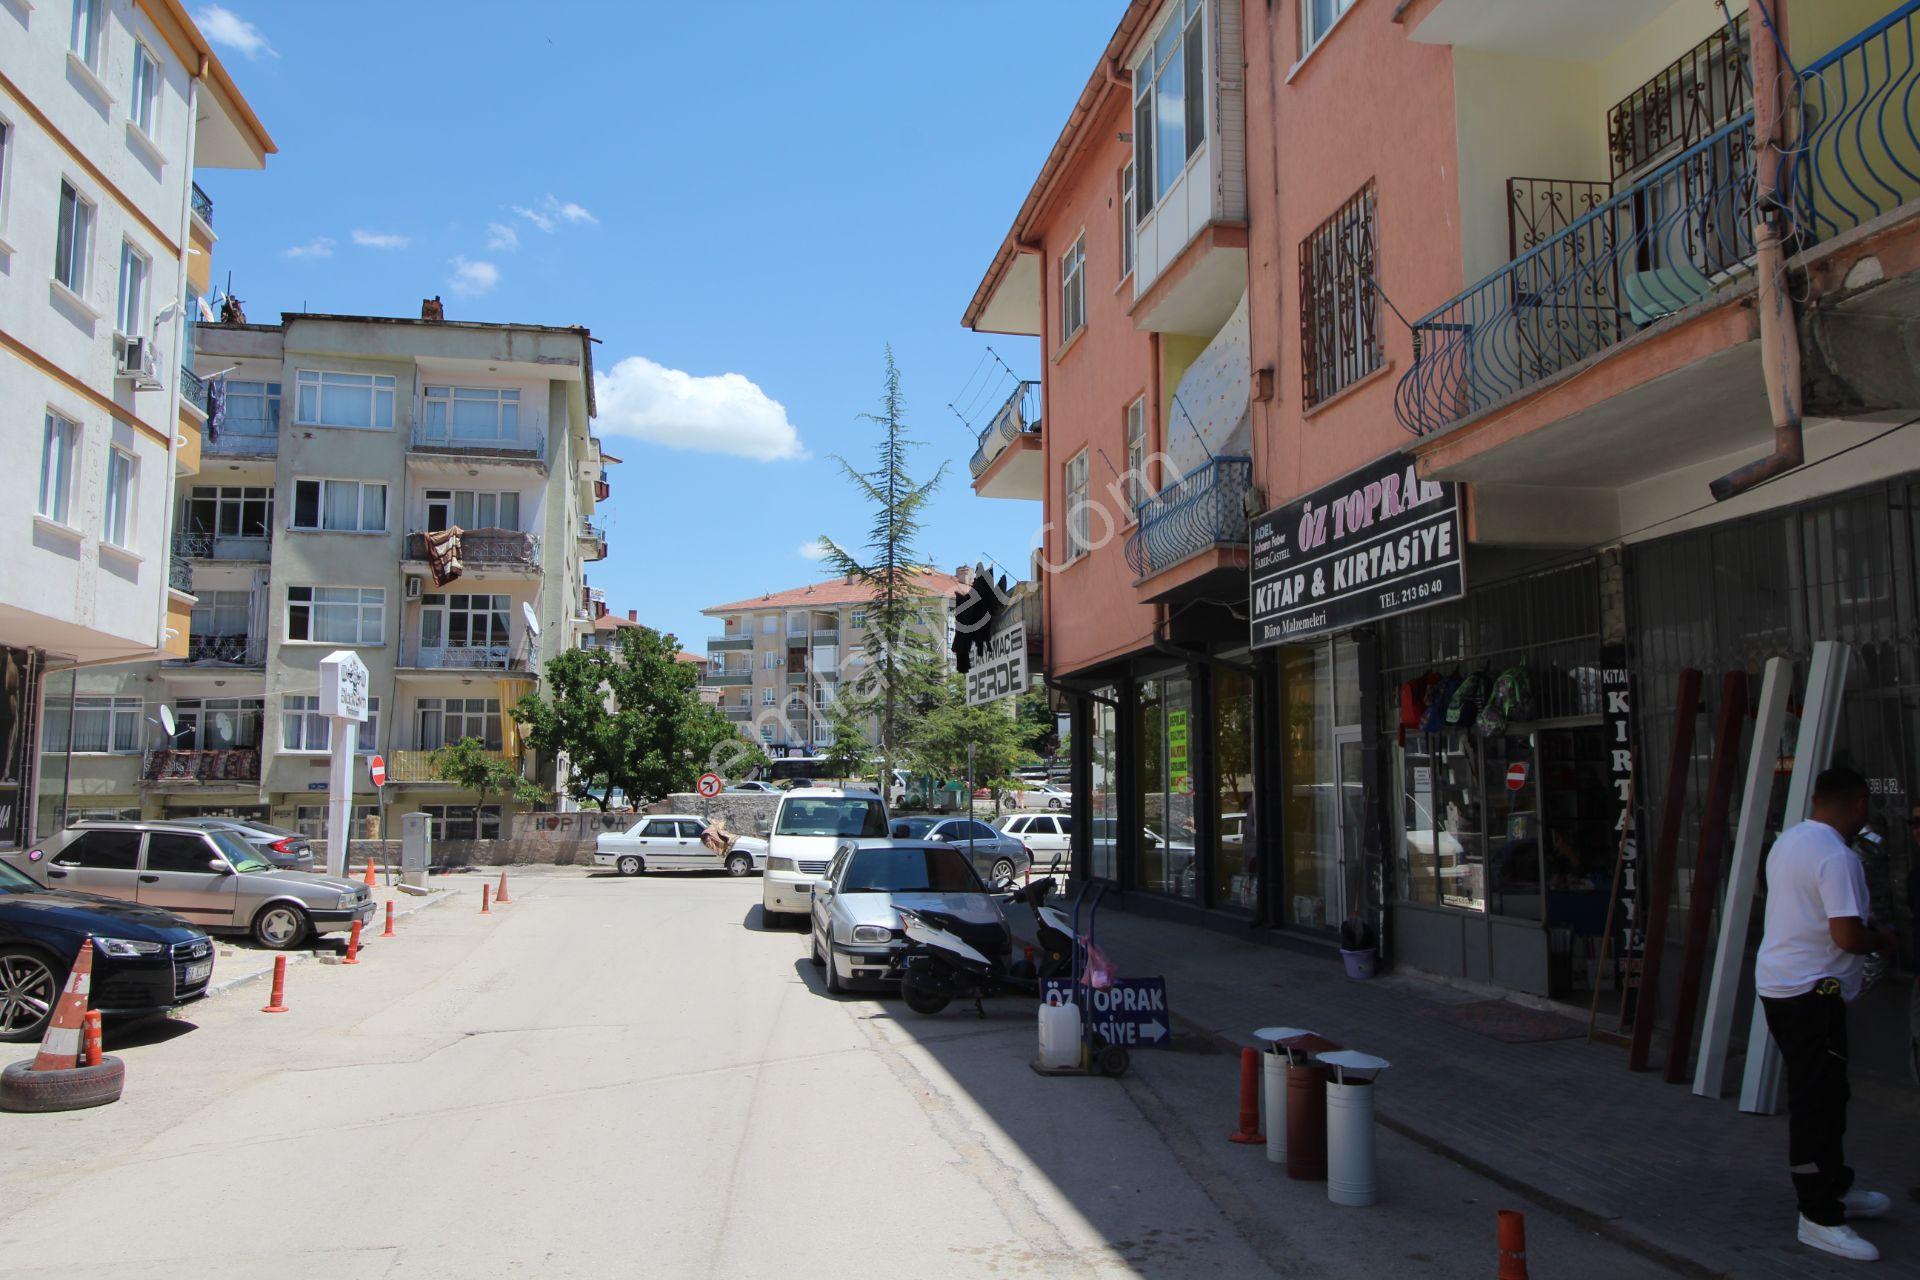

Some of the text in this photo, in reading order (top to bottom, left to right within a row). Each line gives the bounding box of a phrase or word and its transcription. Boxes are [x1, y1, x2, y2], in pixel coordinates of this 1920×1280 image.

[1255, 523, 1273, 541] ADEL
[1297, 502, 1328, 552] ÖZ
[1255, 521, 1451, 615] KİTAP & KIRTASİYE
[1402, 587, 1417, 603] 213
[1418, 584, 1429, 599] 60
[1431, 580, 1442, 594] 40
[1264, 610, 1326, 639] Büro Malzemeleri
[969, 657, 1022, 702] PERDE
[1081, 987, 1164, 1012] OPRAK
